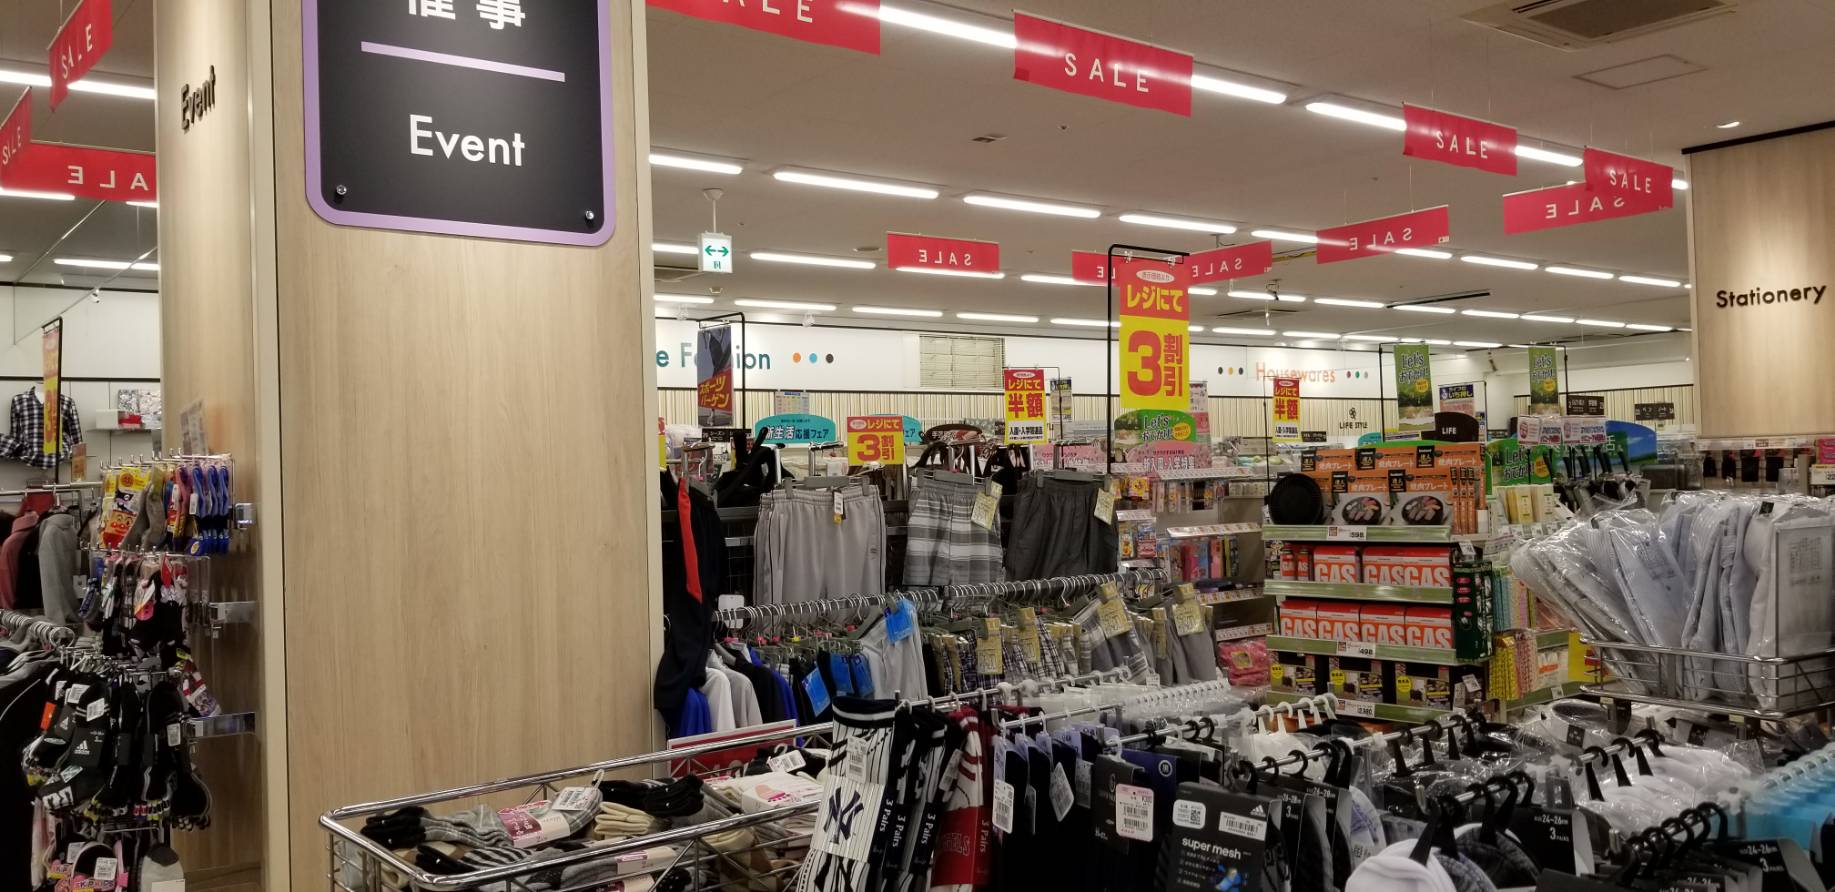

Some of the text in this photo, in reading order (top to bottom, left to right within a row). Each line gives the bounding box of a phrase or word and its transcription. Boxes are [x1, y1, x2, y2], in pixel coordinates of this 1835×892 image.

[1065, 52, 1150, 93] SALE
[181, 65, 216, 134] Event
[409, 113, 526, 167] Event
[1435, 129, 1488, 159] SALE
[1609, 169, 1652, 195] SALE
[1126, 284, 1183, 313] レジにて
[1717, 283, 1827, 310] Stationery
[680, 342, 771, 370] Fion
[700, 374, 726, 395] スポーツ
[1007, 379, 1041, 391] レジにて
[1256, 363, 1337, 387] Housewares
[1275, 386, 1299, 397] レジにて
[1008, 391, 1044, 418] 半額
[1274, 397, 1298, 420] 半額
[867, 419, 900, 429] レジにて
[1143, 414, 1169, 430] Let's
[1442, 426, 1457, 436] LIFE
[1315, 564, 1356, 585] GAS
[1363, 564, 1404, 587] GAS
[1404, 566, 1450, 588] GAS
[1281, 617, 1316, 640] GAS
[1317, 620, 1359, 643] GAS
[1361, 623, 1404, 646] GAS
[1407, 625, 1451, 650] GAS
[880, 808, 891, 832] Pairs
[892, 824, 904, 848] Pairs
[921, 822, 934, 845] Pairs
[980, 829, 989, 853] Pairs
[1549, 826, 1556, 841] 3
[1182, 837, 1241, 860] super mesh
